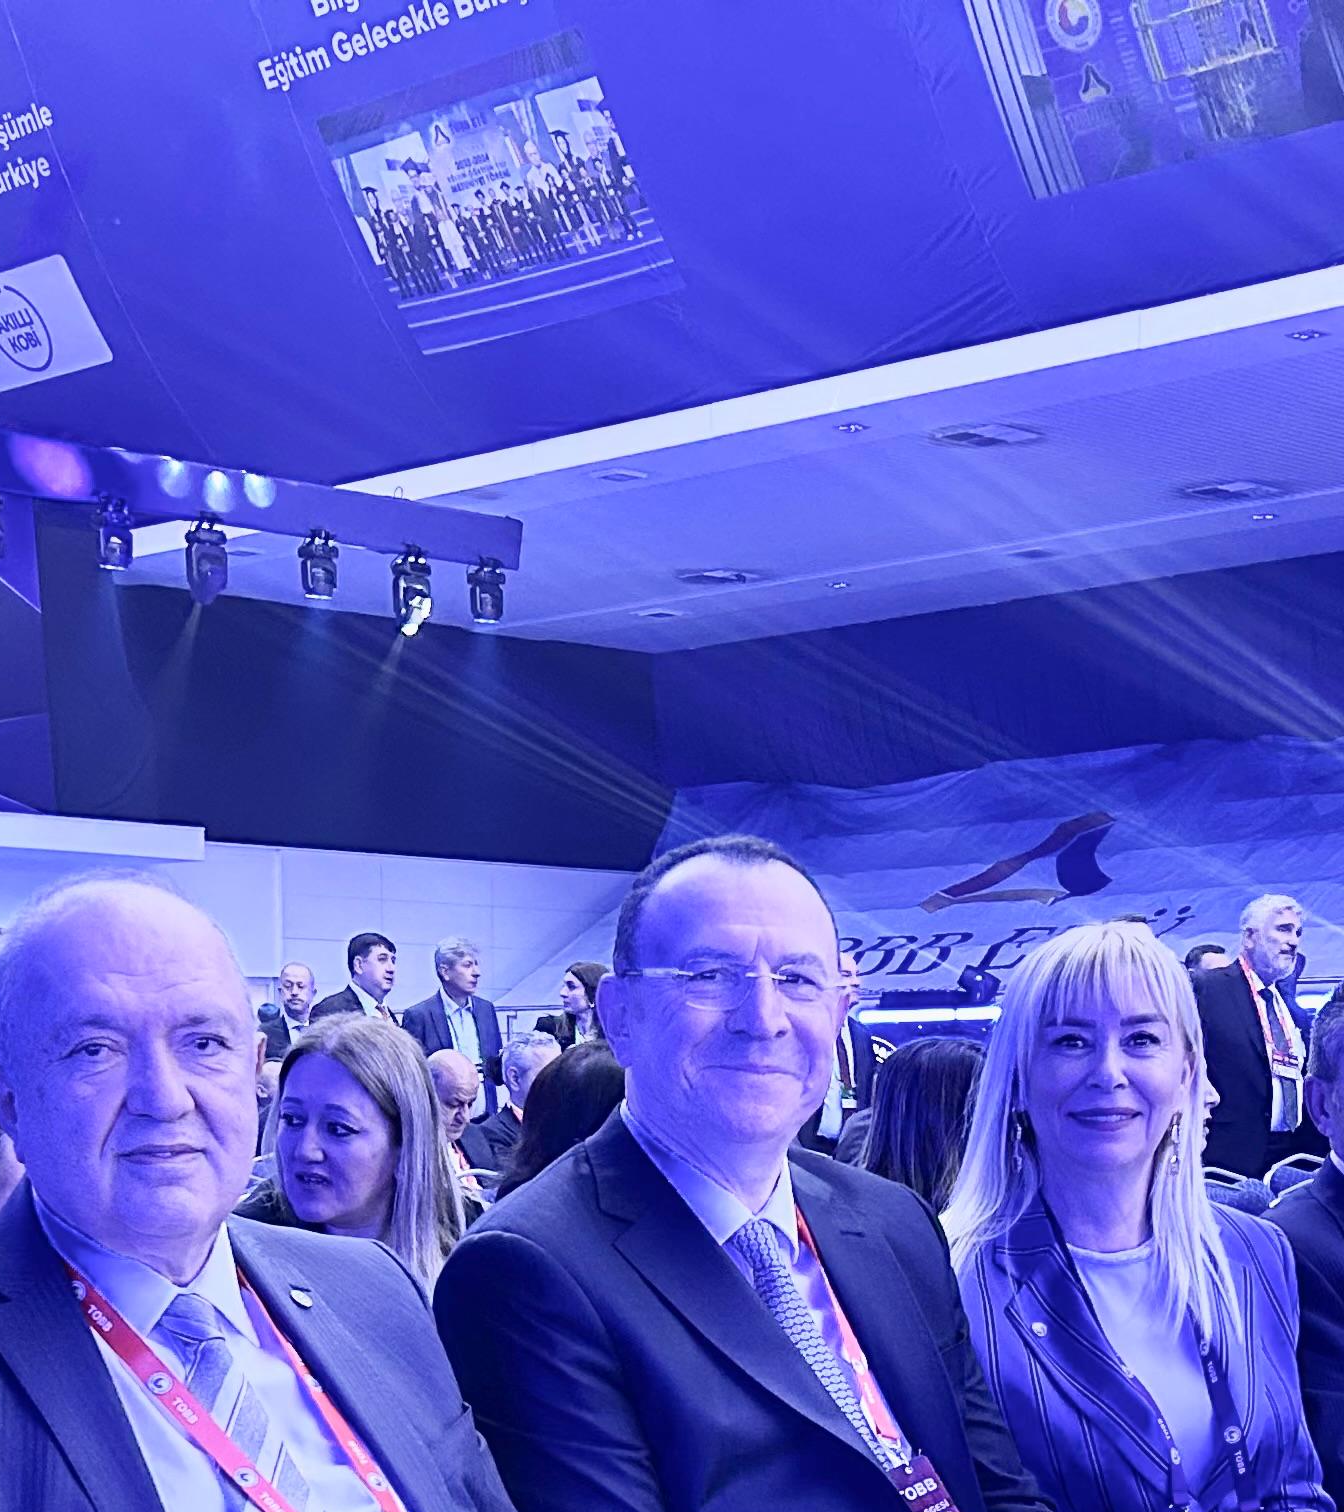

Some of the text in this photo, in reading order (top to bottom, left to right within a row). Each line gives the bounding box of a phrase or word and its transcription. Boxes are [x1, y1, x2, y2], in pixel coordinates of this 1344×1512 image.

[258, 0, 450, 92] Eğitim Gelecekle
[8, 325, 43, 354] KOBİ
